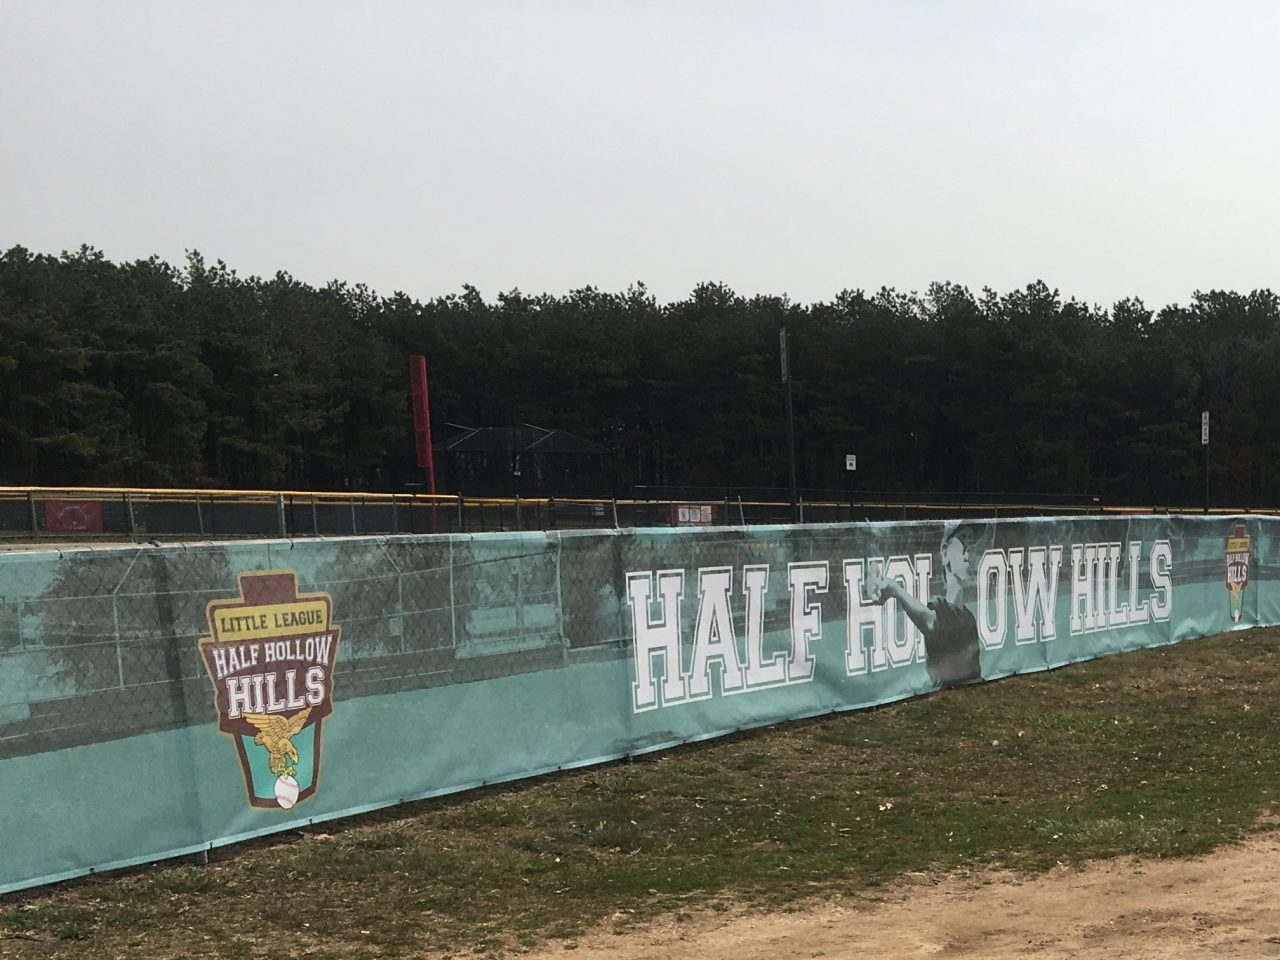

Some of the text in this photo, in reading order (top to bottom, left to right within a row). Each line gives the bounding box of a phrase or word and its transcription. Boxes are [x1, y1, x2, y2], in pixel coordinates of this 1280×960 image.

[1228, 564, 1247, 583] HILLS
[220, 609, 323, 633] LITTLE LEAGUE
[625, 540, 1172, 714] HALF HOLOW HILLS
[212, 634, 333, 680] HALF HOLLOW
[225, 665, 326, 720] HILLS
